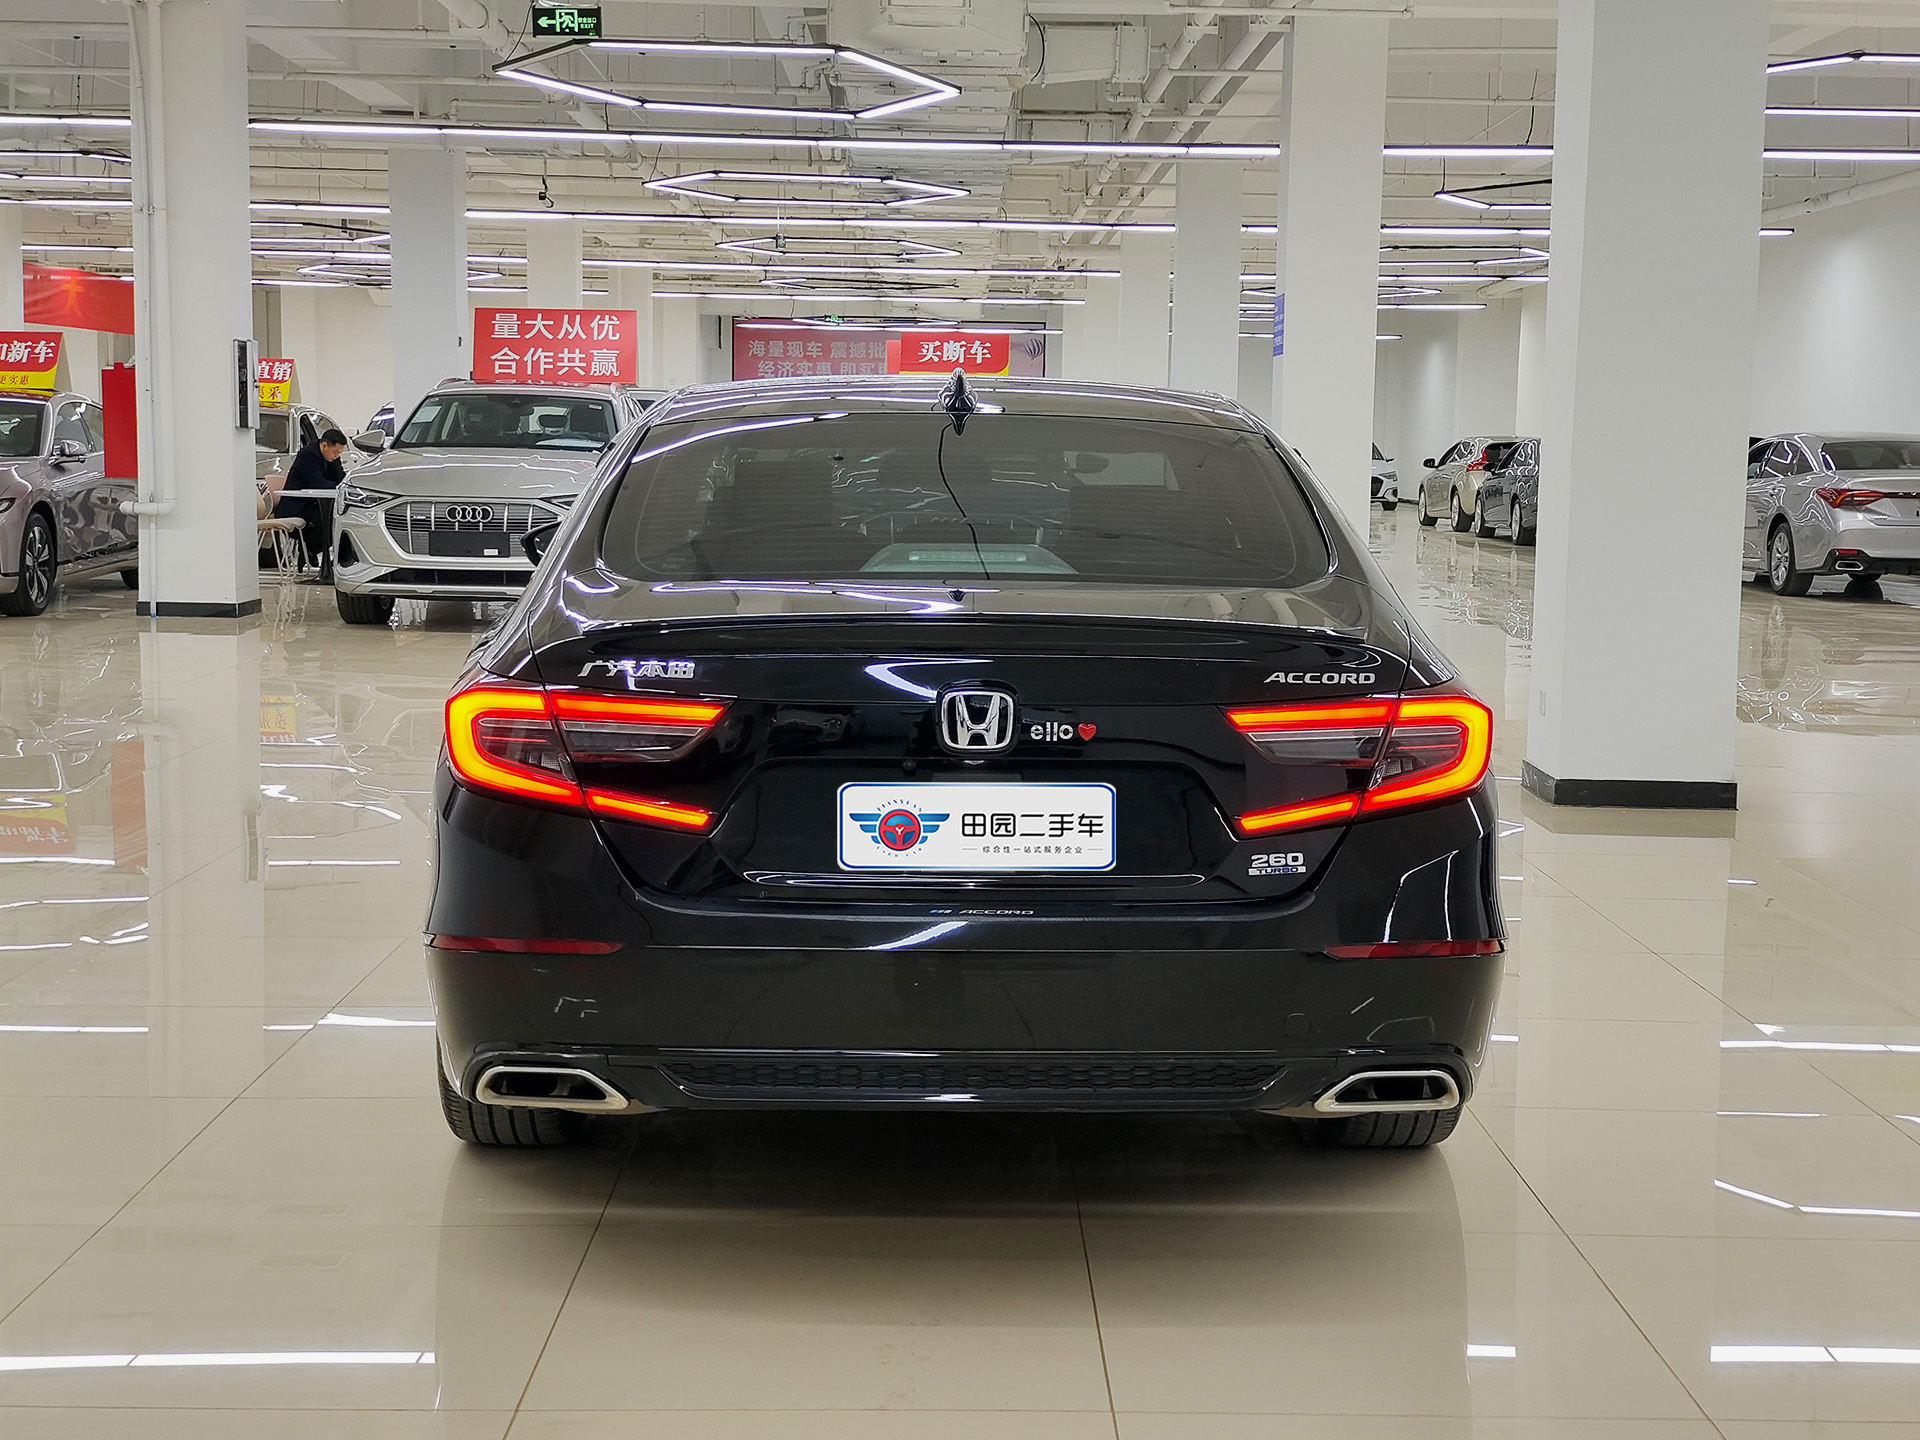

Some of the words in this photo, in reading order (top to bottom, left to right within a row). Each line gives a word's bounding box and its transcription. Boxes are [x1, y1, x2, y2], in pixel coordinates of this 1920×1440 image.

[490, 313, 620, 341] 量大从优
[748, 340, 823, 358] 海量现车
[918, 340, 992, 364] 买断车
[258, 361, 293, 381] 直销
[490, 346, 620, 377] 合作共赢
[577, 660, 696, 678] 广汽本田
[1263, 672, 1376, 684] ACCORD
[1030, 722, 1074, 742] ello
[1251, 852, 1304, 868] 260
[1256, 866, 1299, 875] TURBO
